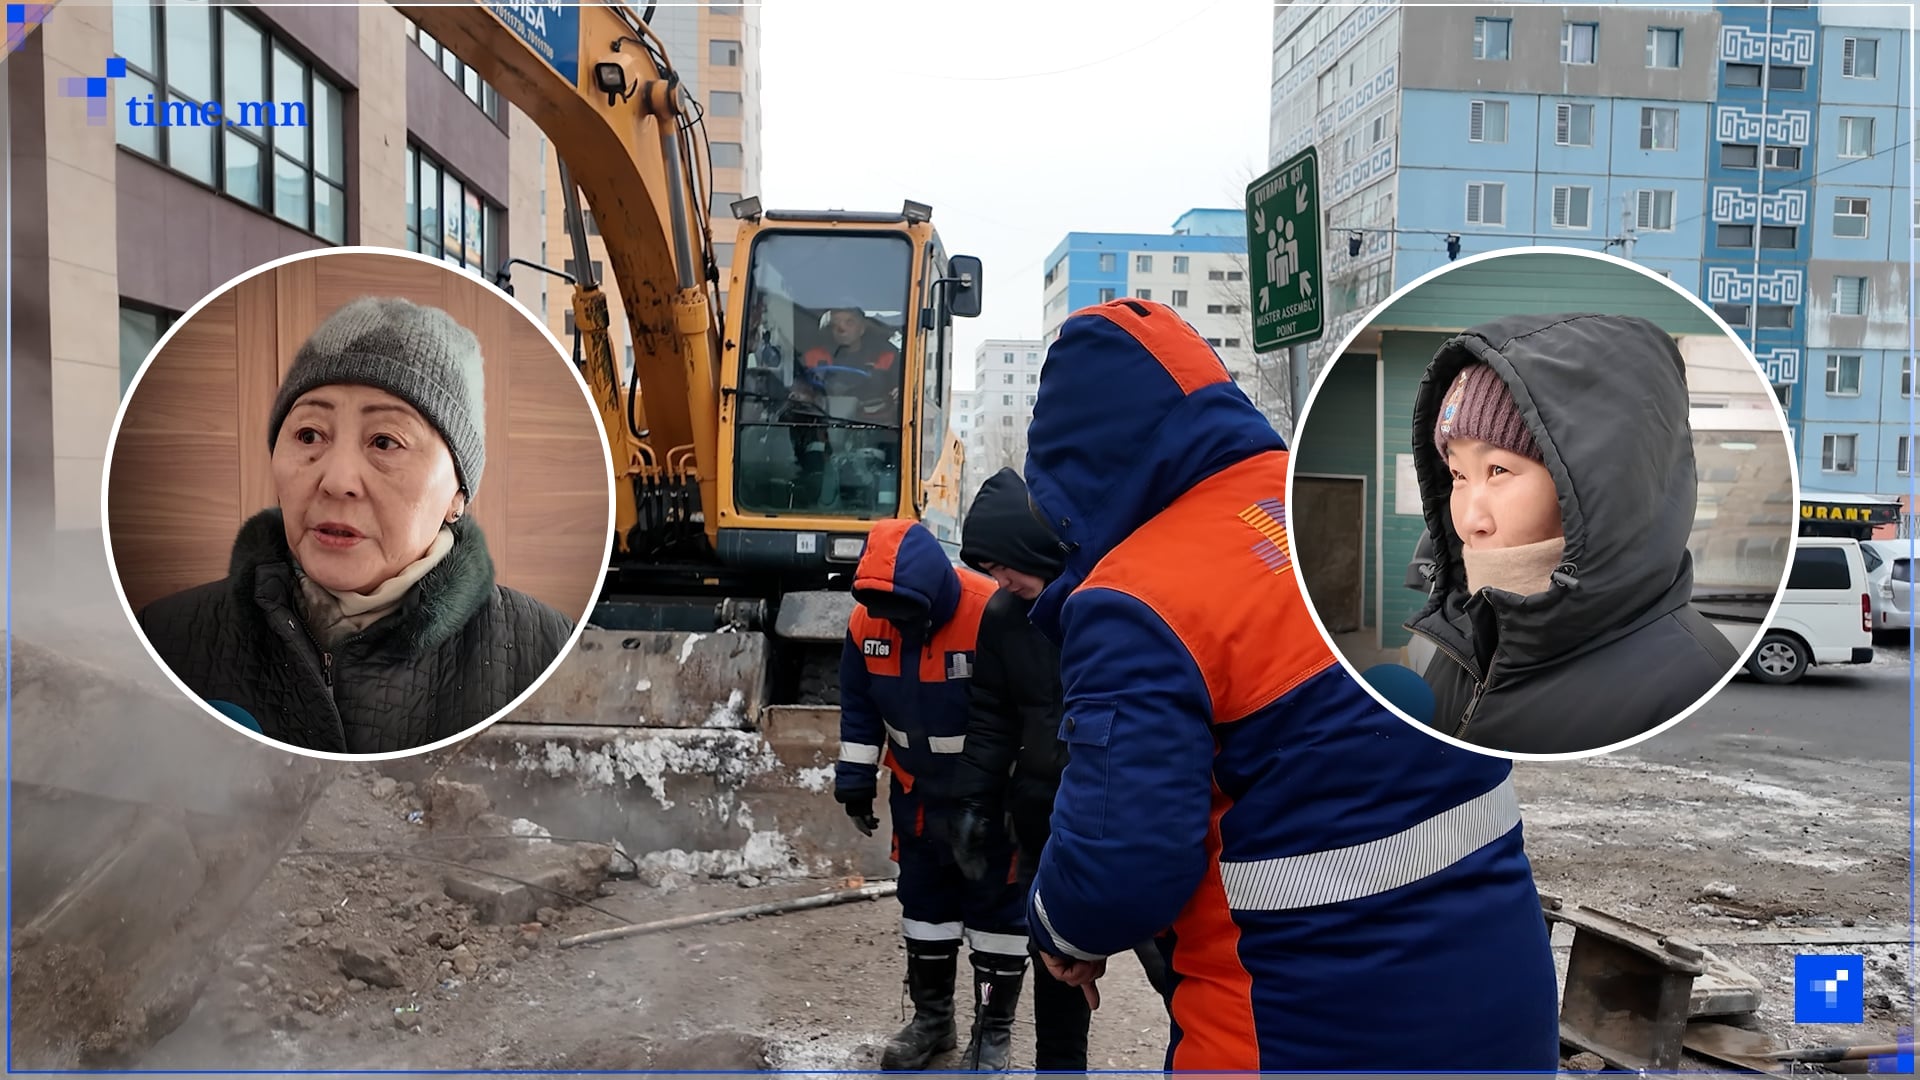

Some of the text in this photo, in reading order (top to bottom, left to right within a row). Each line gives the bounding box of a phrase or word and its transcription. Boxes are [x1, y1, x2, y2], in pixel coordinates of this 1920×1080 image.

[1256, 297, 1317, 328] MUSTER ASSEMBLY
[1276, 321, 1297, 338] POINT
[1801, 505, 1872, 522] URANT
